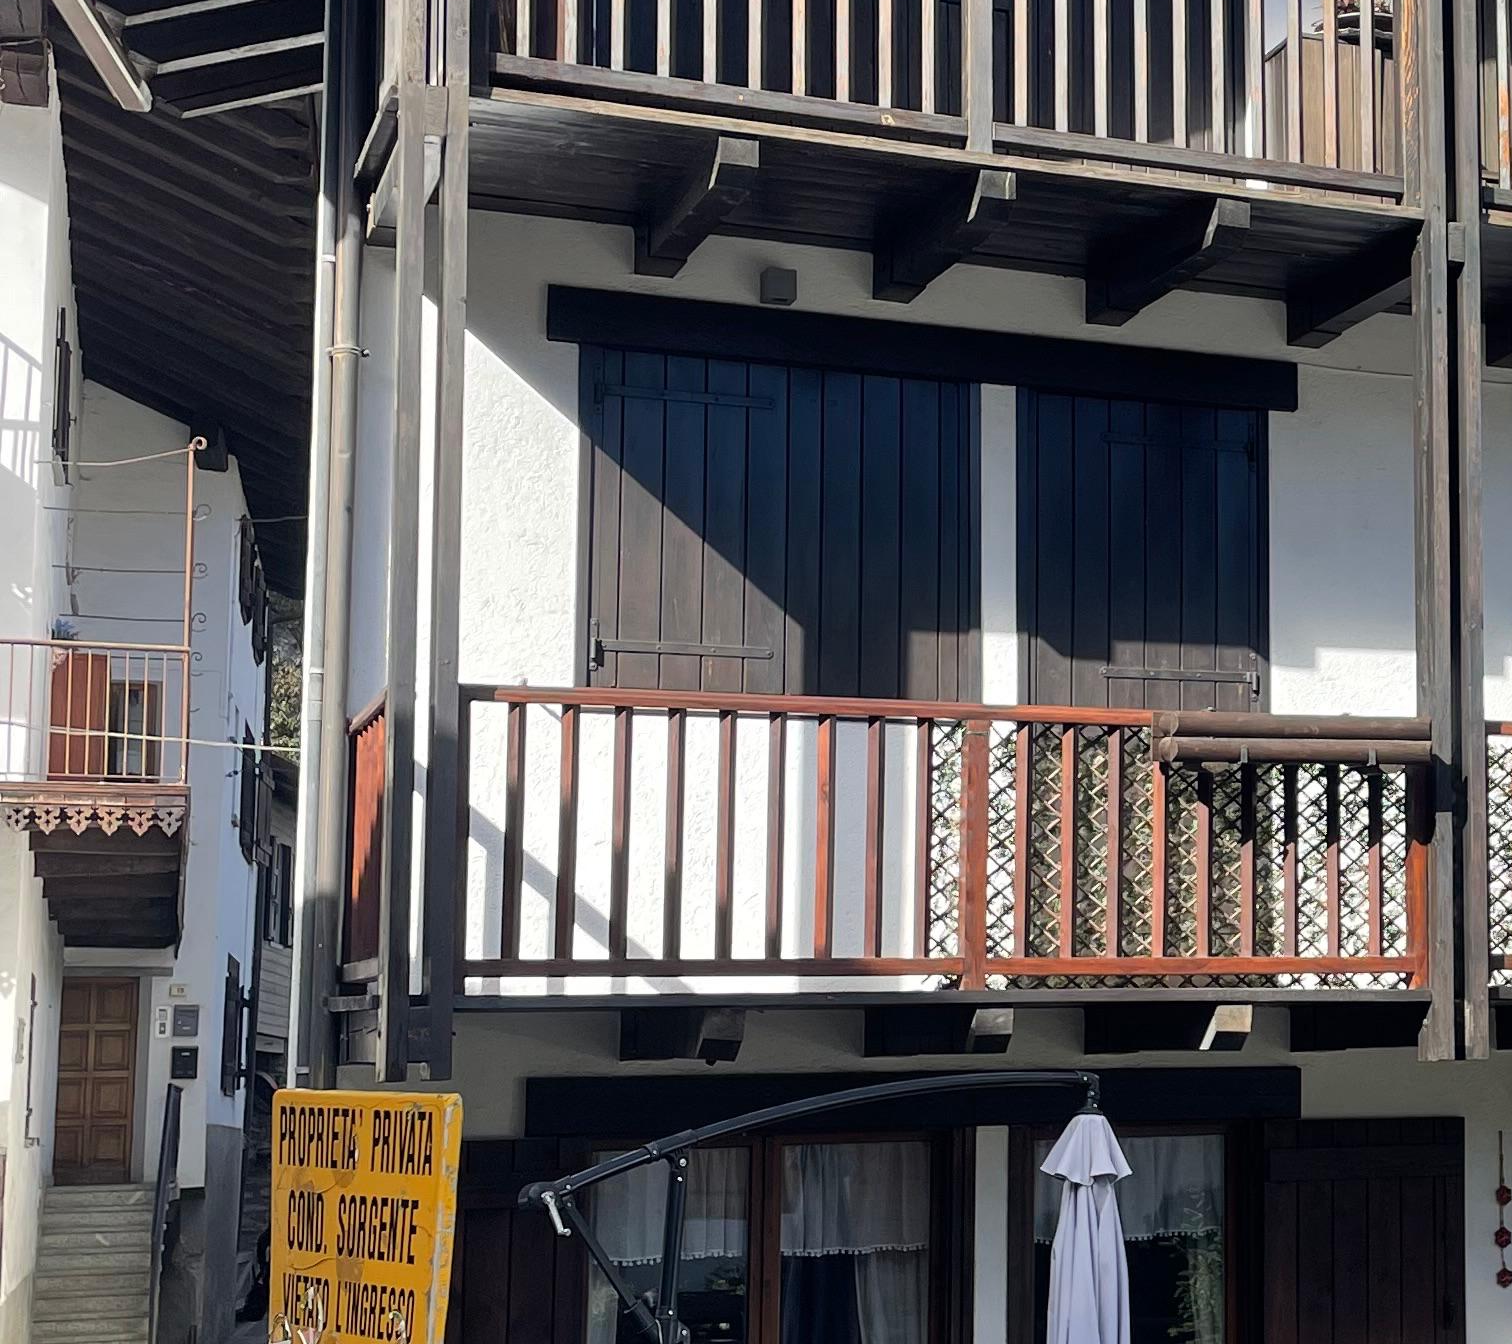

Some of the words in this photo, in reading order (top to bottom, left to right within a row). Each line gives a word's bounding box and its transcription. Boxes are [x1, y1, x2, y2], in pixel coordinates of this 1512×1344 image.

[280, 1106, 363, 1170] PROPRIETA'
[371, 1110, 433, 1176] PRIVATA
[288, 1189, 328, 1254] COND.
[337, 1194, 419, 1264] SORGENTE
[283, 1272, 329, 1331] VIETATO
[335, 1280, 415, 1344] L'INGRESSO
